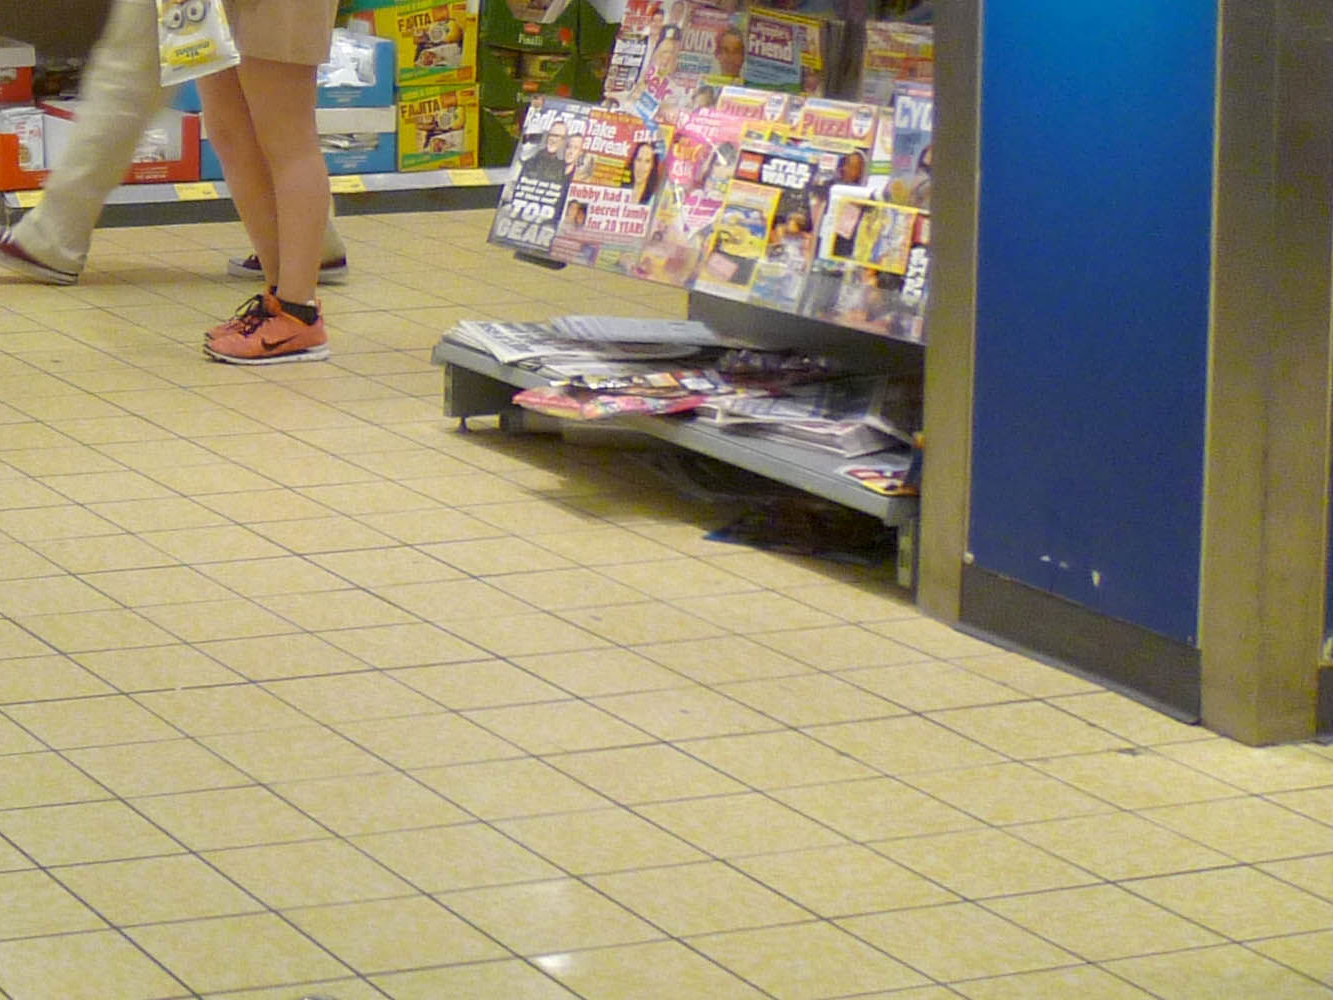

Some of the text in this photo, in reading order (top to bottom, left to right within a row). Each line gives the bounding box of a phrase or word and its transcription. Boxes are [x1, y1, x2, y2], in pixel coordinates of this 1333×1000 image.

[588, 119, 618, 139] Take
[592, 136, 630, 157] Break
[770, 158, 811, 175] STAR
[761, 169, 812, 190] WARS
[570, 184, 600, 202] Hubby
[603, 186, 622, 201] had
[509, 199, 556, 224] TOP
[589, 203, 649, 221] secret family
[496, 218, 557, 247] GEAR
[587, 217, 646, 233] for YEARS
